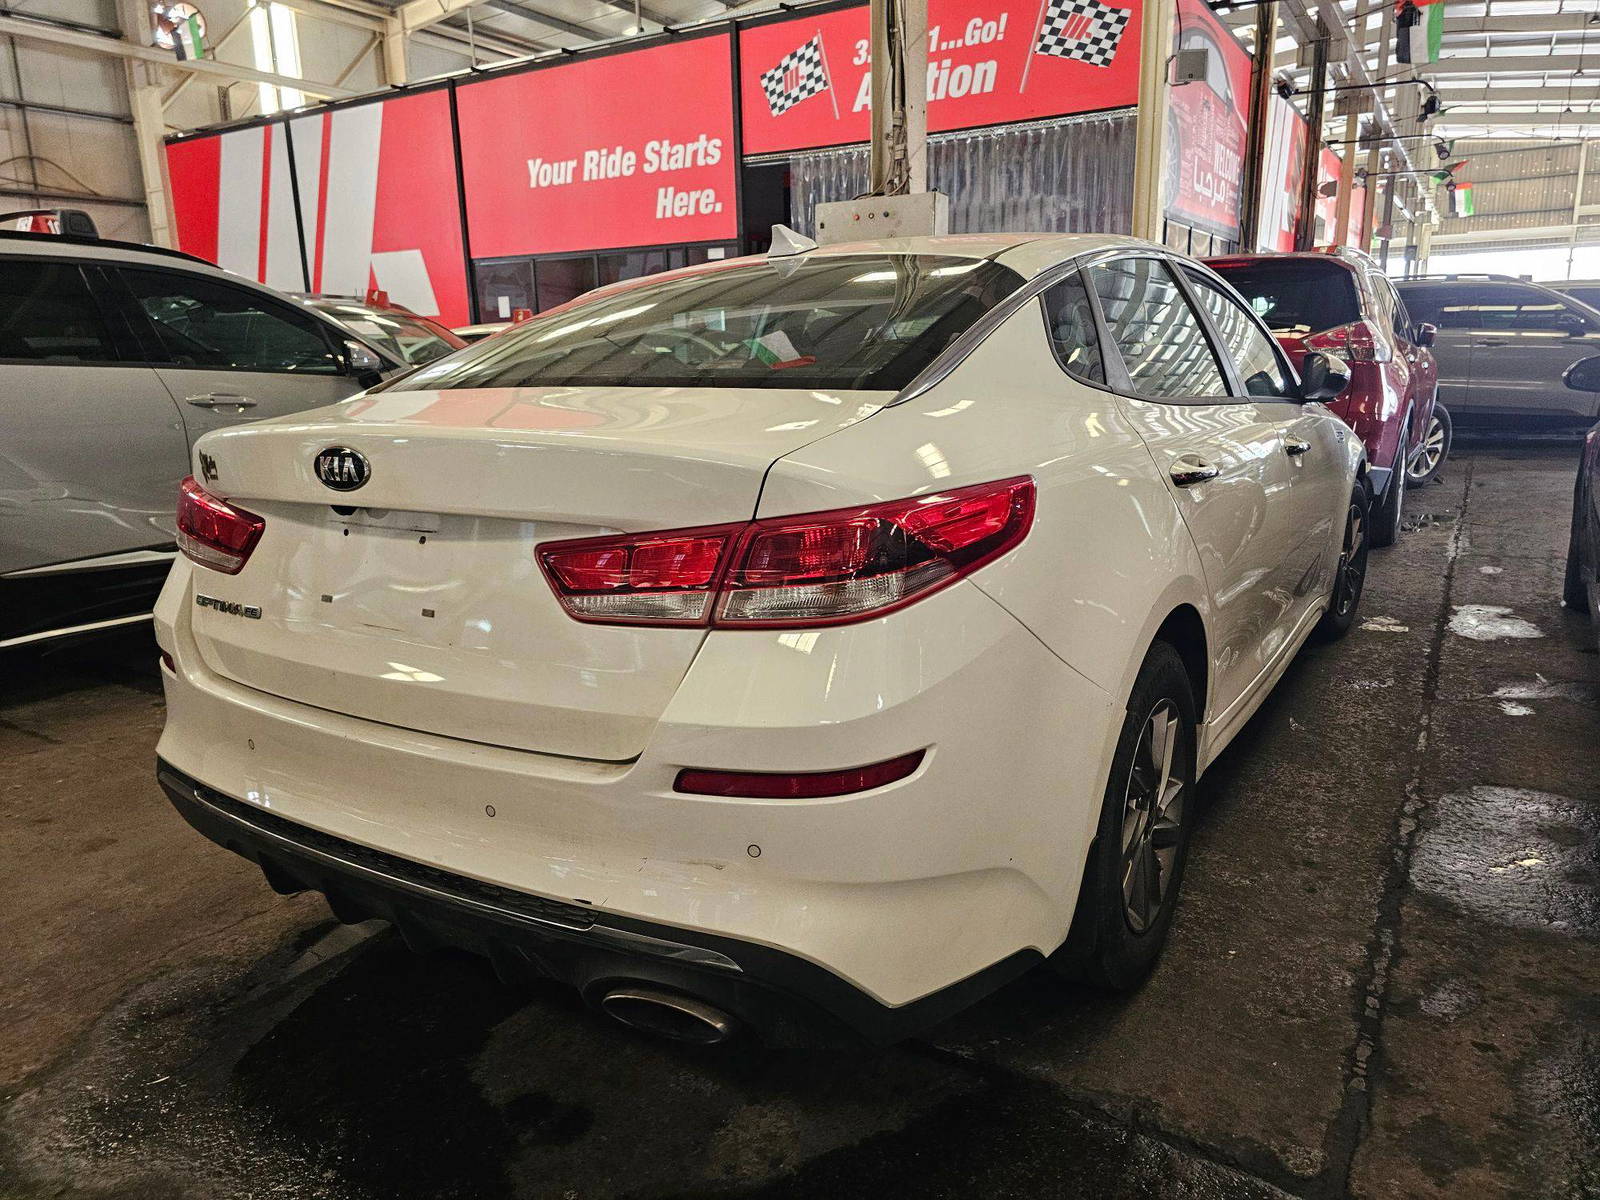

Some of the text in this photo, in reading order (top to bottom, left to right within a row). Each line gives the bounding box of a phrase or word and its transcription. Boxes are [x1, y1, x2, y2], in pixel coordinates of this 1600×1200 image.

[852, 58, 997, 113] Ation
[527, 133, 722, 188] Your Ride Starts
[656, 186, 722, 219] Here.
[319, 456, 360, 482] KIA
